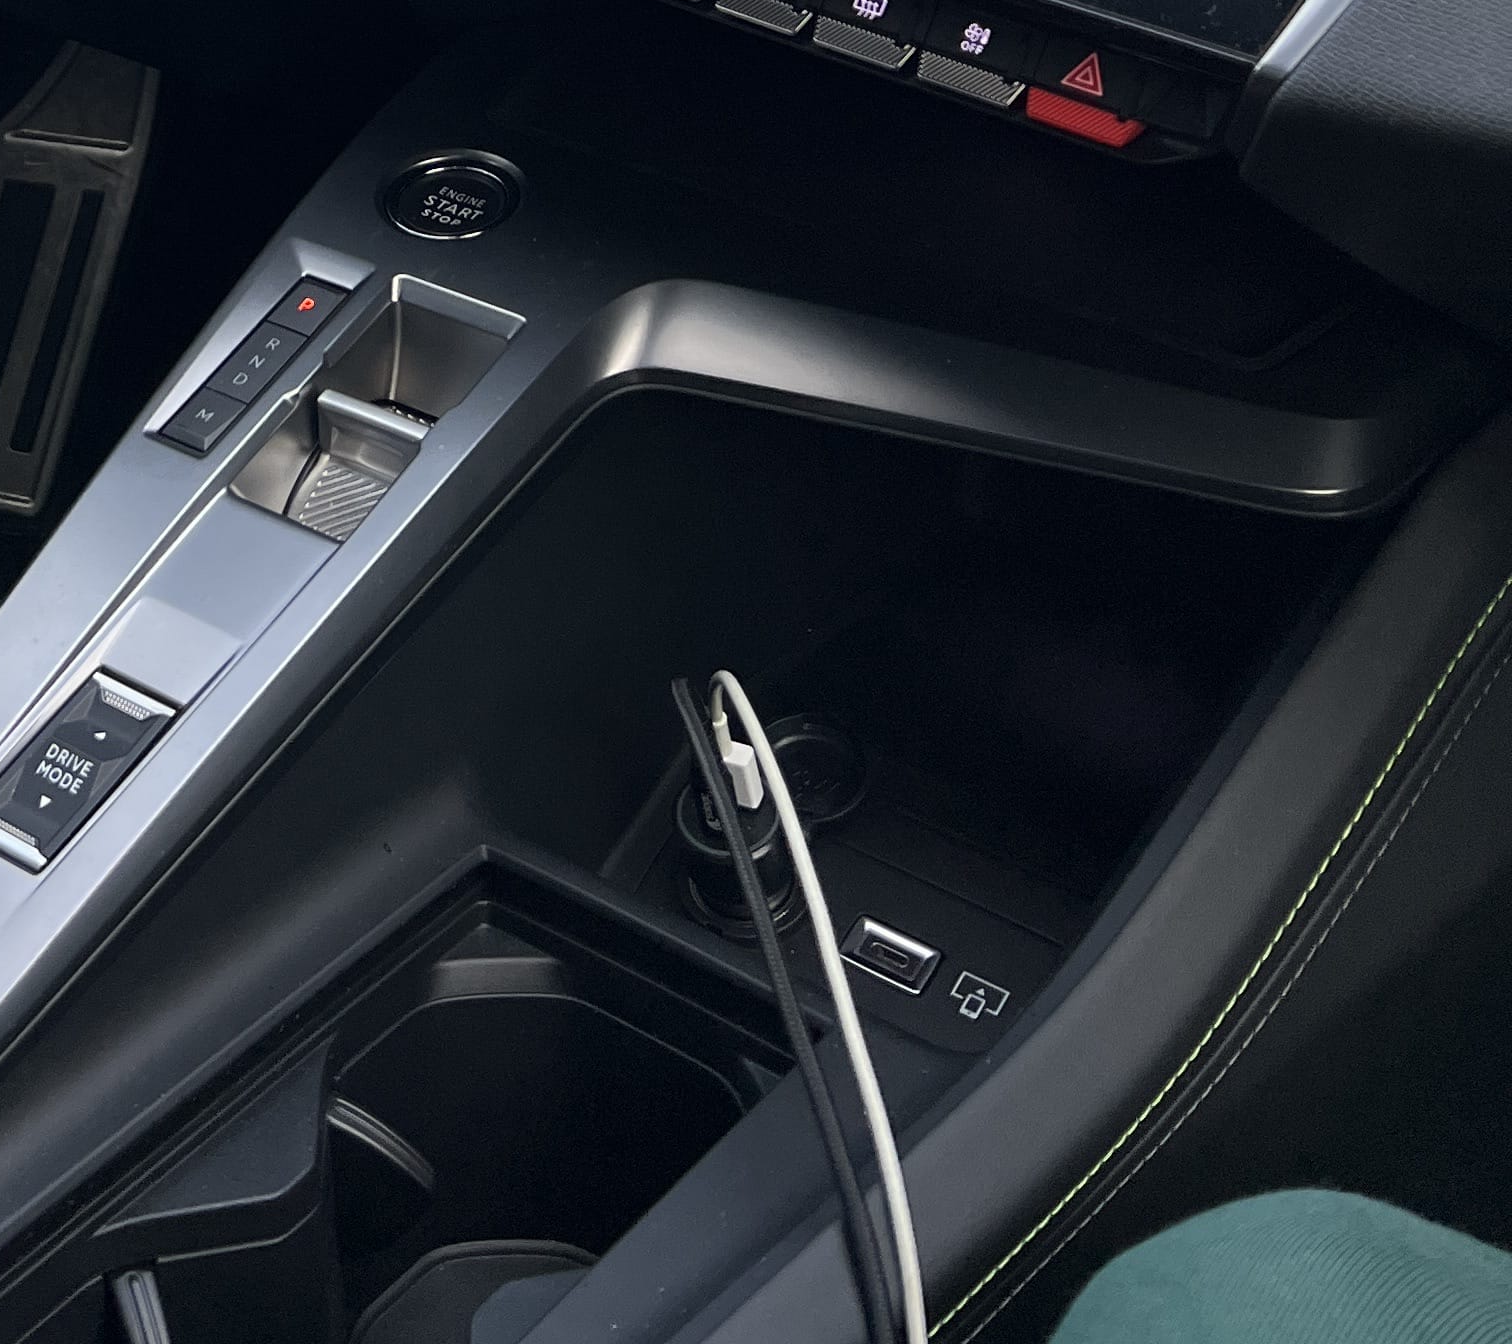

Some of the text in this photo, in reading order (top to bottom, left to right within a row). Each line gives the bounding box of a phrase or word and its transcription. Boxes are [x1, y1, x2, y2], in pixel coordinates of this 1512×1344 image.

[960, 40, 984, 55] OFF
[438, 185, 487, 209] ENGINE
[423, 194, 484, 221] START
[421, 208, 461, 226] STOP
[297, 296, 316, 312] P
[265, 337, 281, 351] R
[248, 355, 265, 369] N
[232, 372, 248, 386] D
[195, 408, 214, 423] M
[45, 743, 94, 778] DRIVE
[36, 760, 85, 795] MODE
